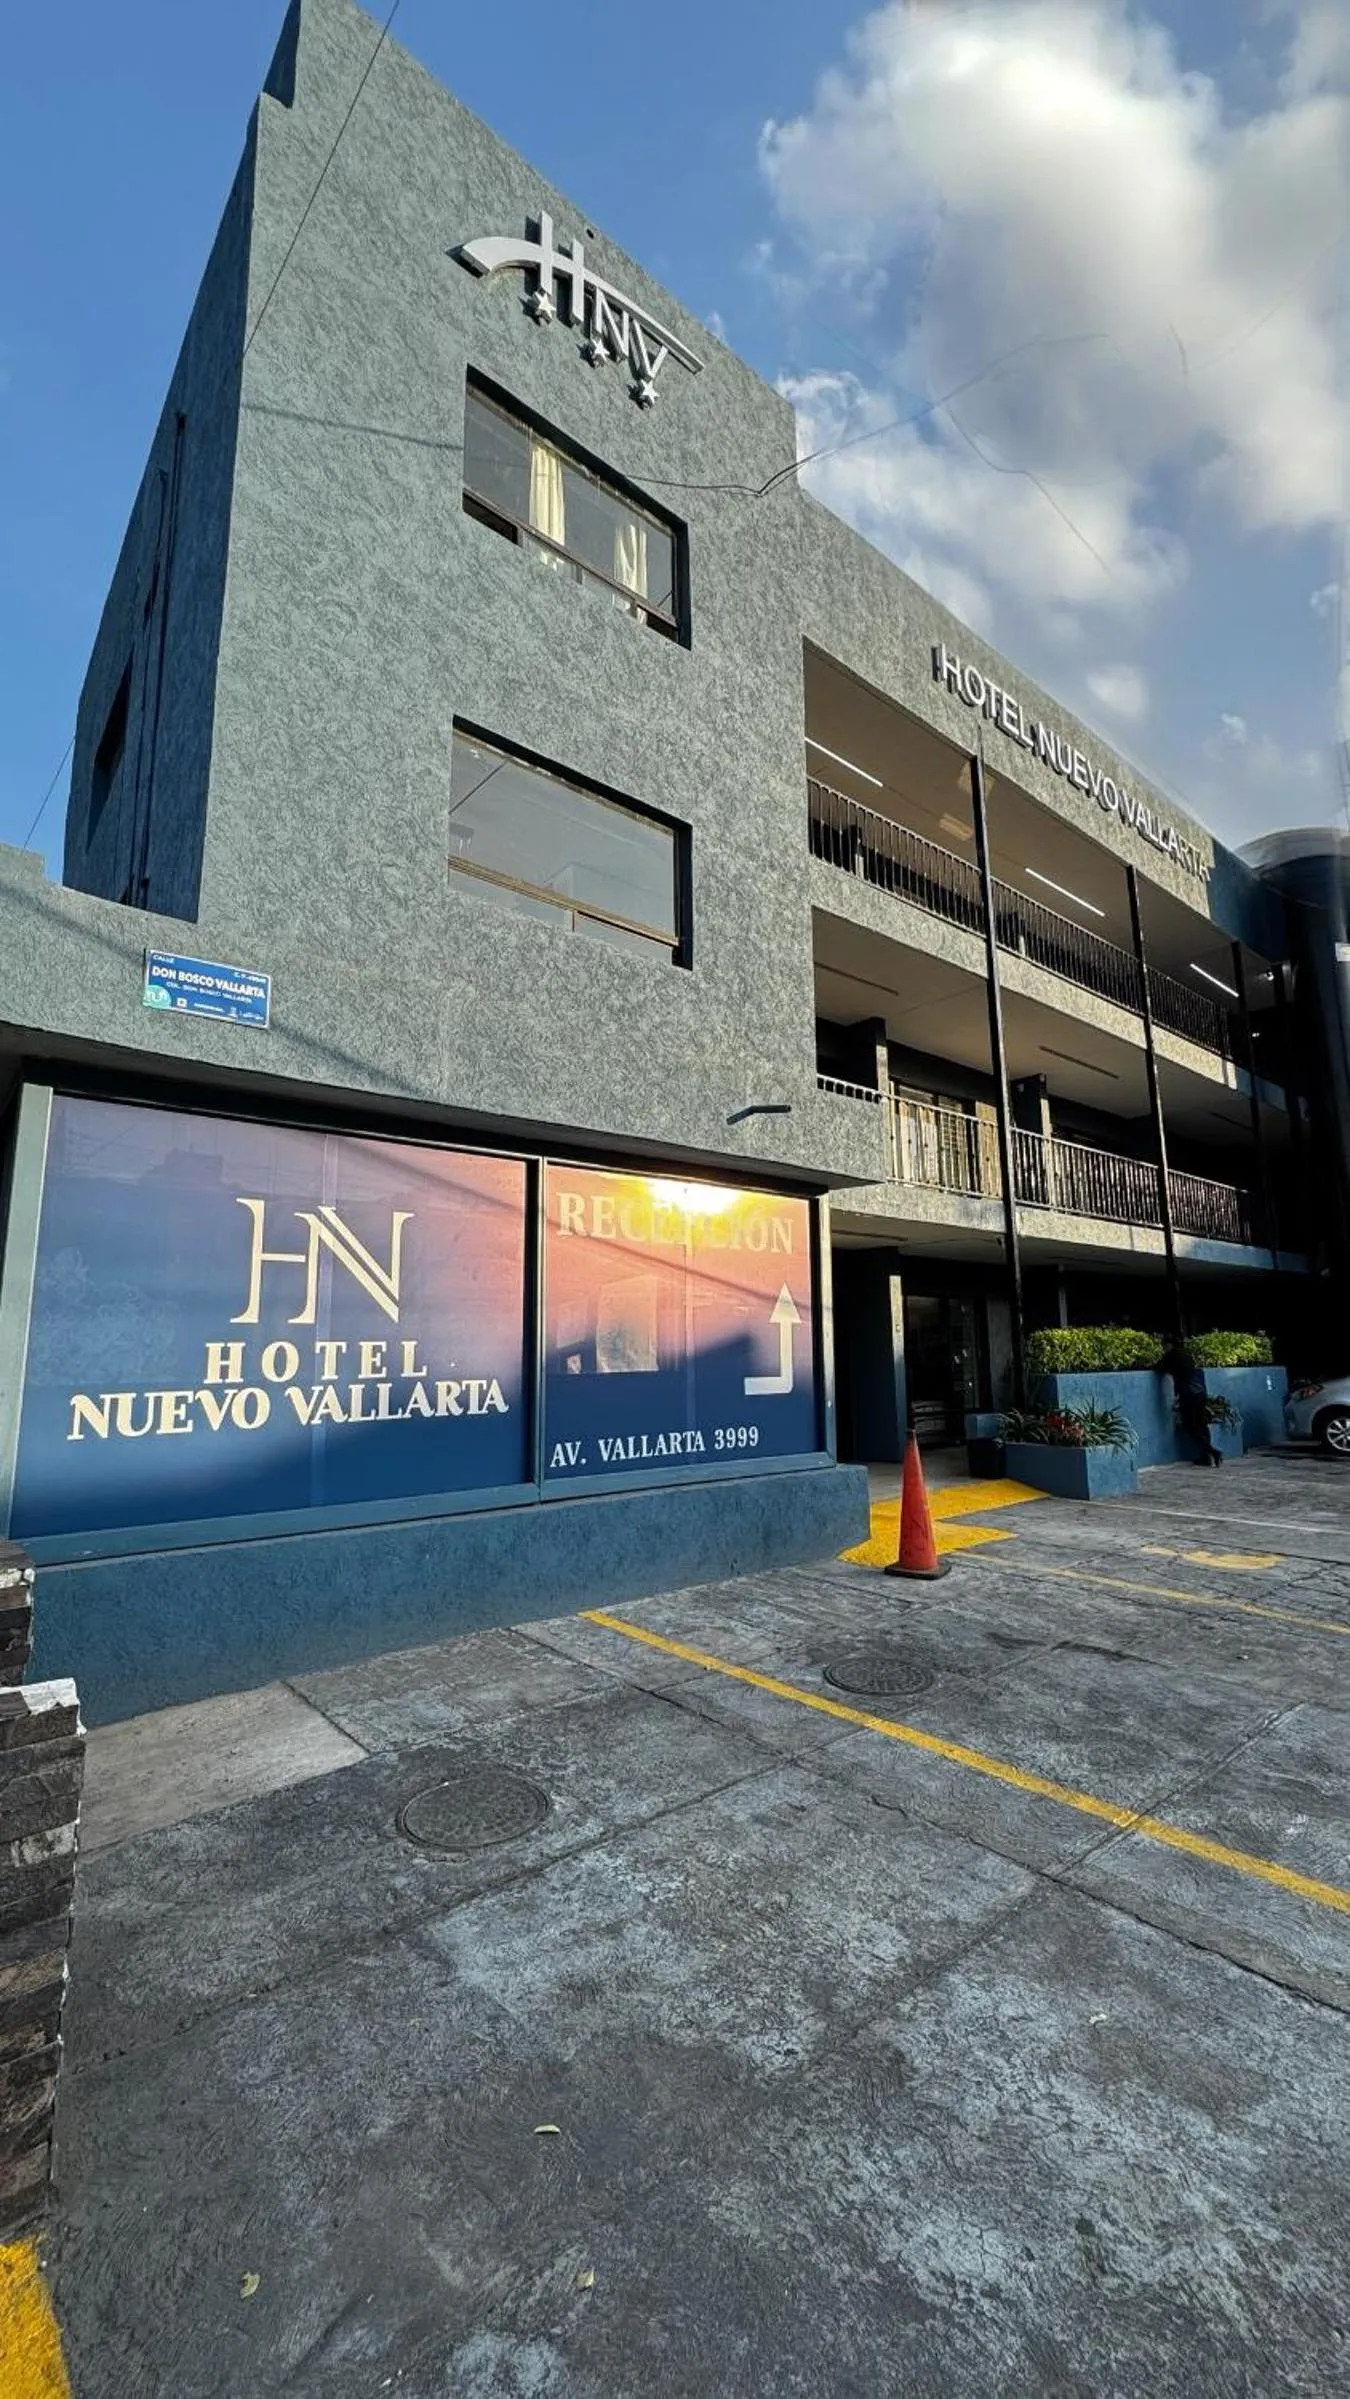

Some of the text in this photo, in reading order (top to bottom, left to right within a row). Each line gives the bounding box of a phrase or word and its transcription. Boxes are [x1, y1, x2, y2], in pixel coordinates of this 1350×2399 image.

[933, 643, 1035, 751] HOTEL
[1033, 721, 1119, 812] NUEVO
[152, 966, 177, 980] DON
[178, 971, 214, 988] BOSCO
[215, 978, 266, 999] VALLARTA
[230, 1198, 414, 1324] HN
[203, 1341, 427, 1385] HOTEL
[67, 1378, 509, 1440] NUEVO VALLARTA
[550, 1426, 760, 1468] AV. VALLARTA 3999
